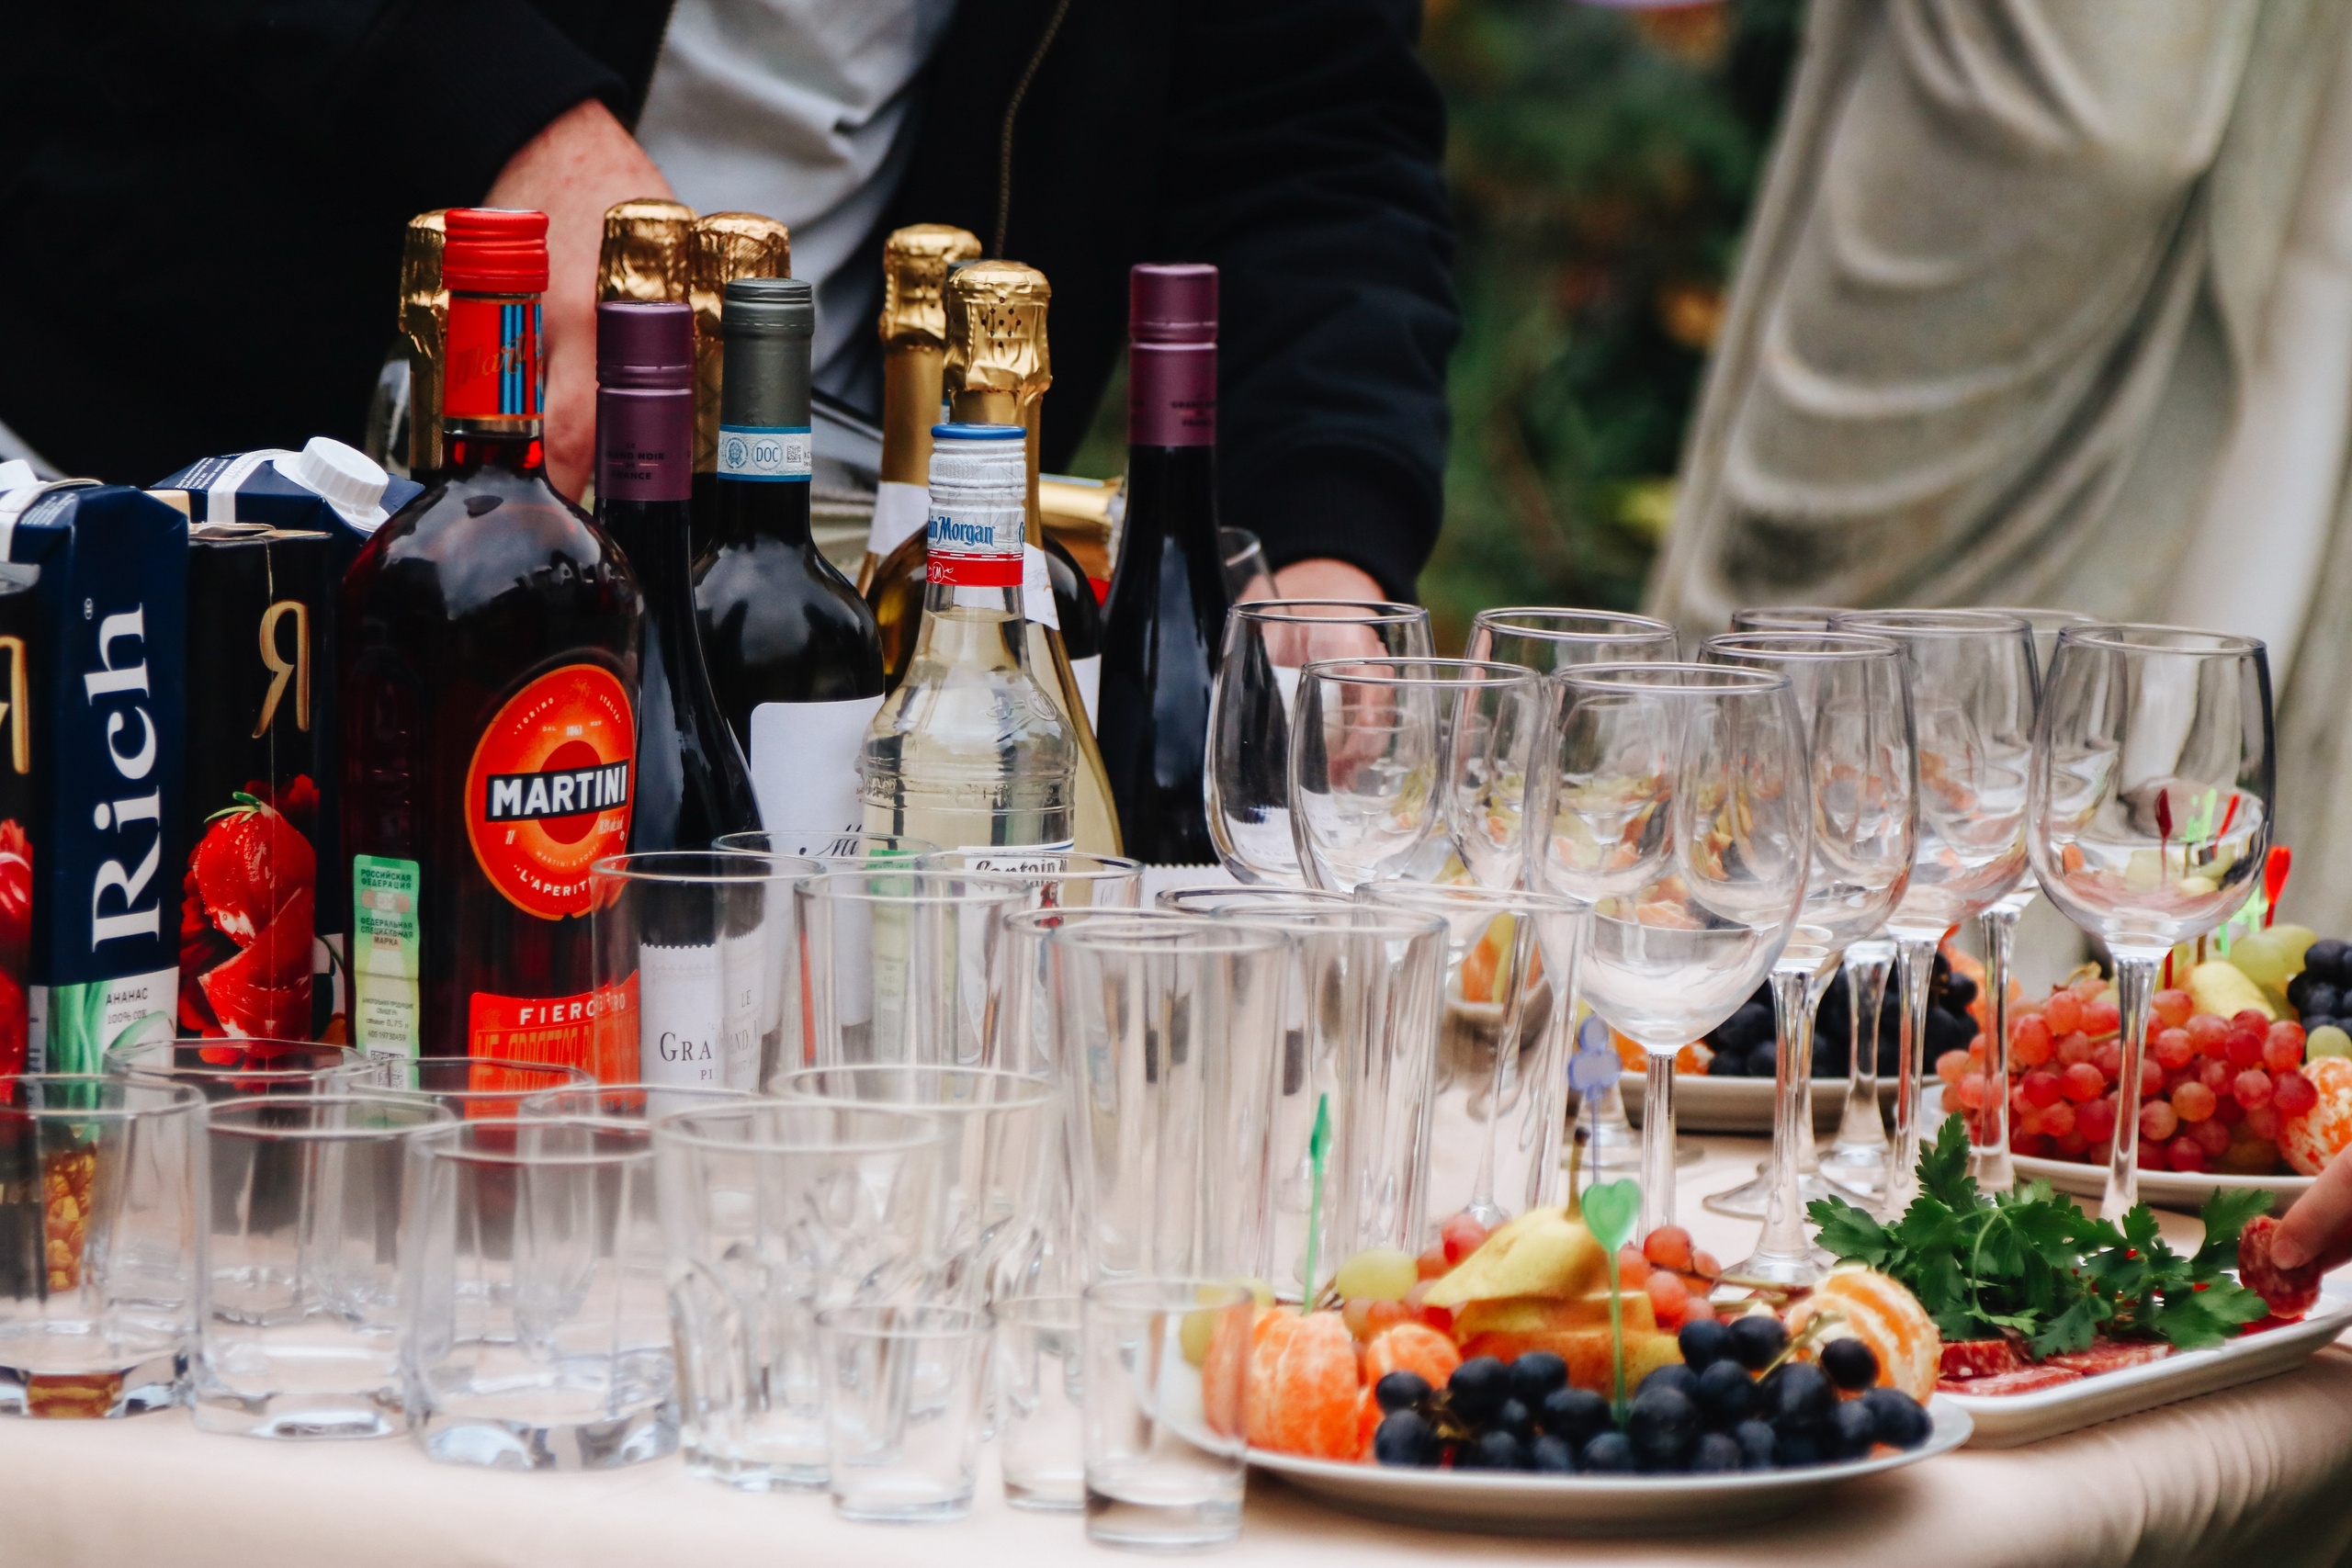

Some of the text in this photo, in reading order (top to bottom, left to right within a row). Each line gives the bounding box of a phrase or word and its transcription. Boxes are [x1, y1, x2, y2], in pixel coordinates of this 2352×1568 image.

[638, 453, 665, 461] NOIR
[756, 446, 779, 463] DOC
[936, 516, 995, 547] Morgan
[516, 694, 620, 730] TORINO ITALIA
[84, 602, 161, 953] Rich
[492, 764, 628, 817] MARTINI
[536, 850, 569, 867] MARTINI
[361, 869, 412, 882] РОССИЙСКАЯ
[361, 877, 412, 890] ФЕДЕРАЦИЯ
[360, 917, 413, 930] ФЕДЕРАЛЬНАЯ
[360, 926, 413, 938] СПЕЦИАЛЬНАЯ
[374, 936, 399, 946] МАРКА
[106, 987, 148, 1006] АНАНАС
[107, 1011, 132, 1024] 100%
